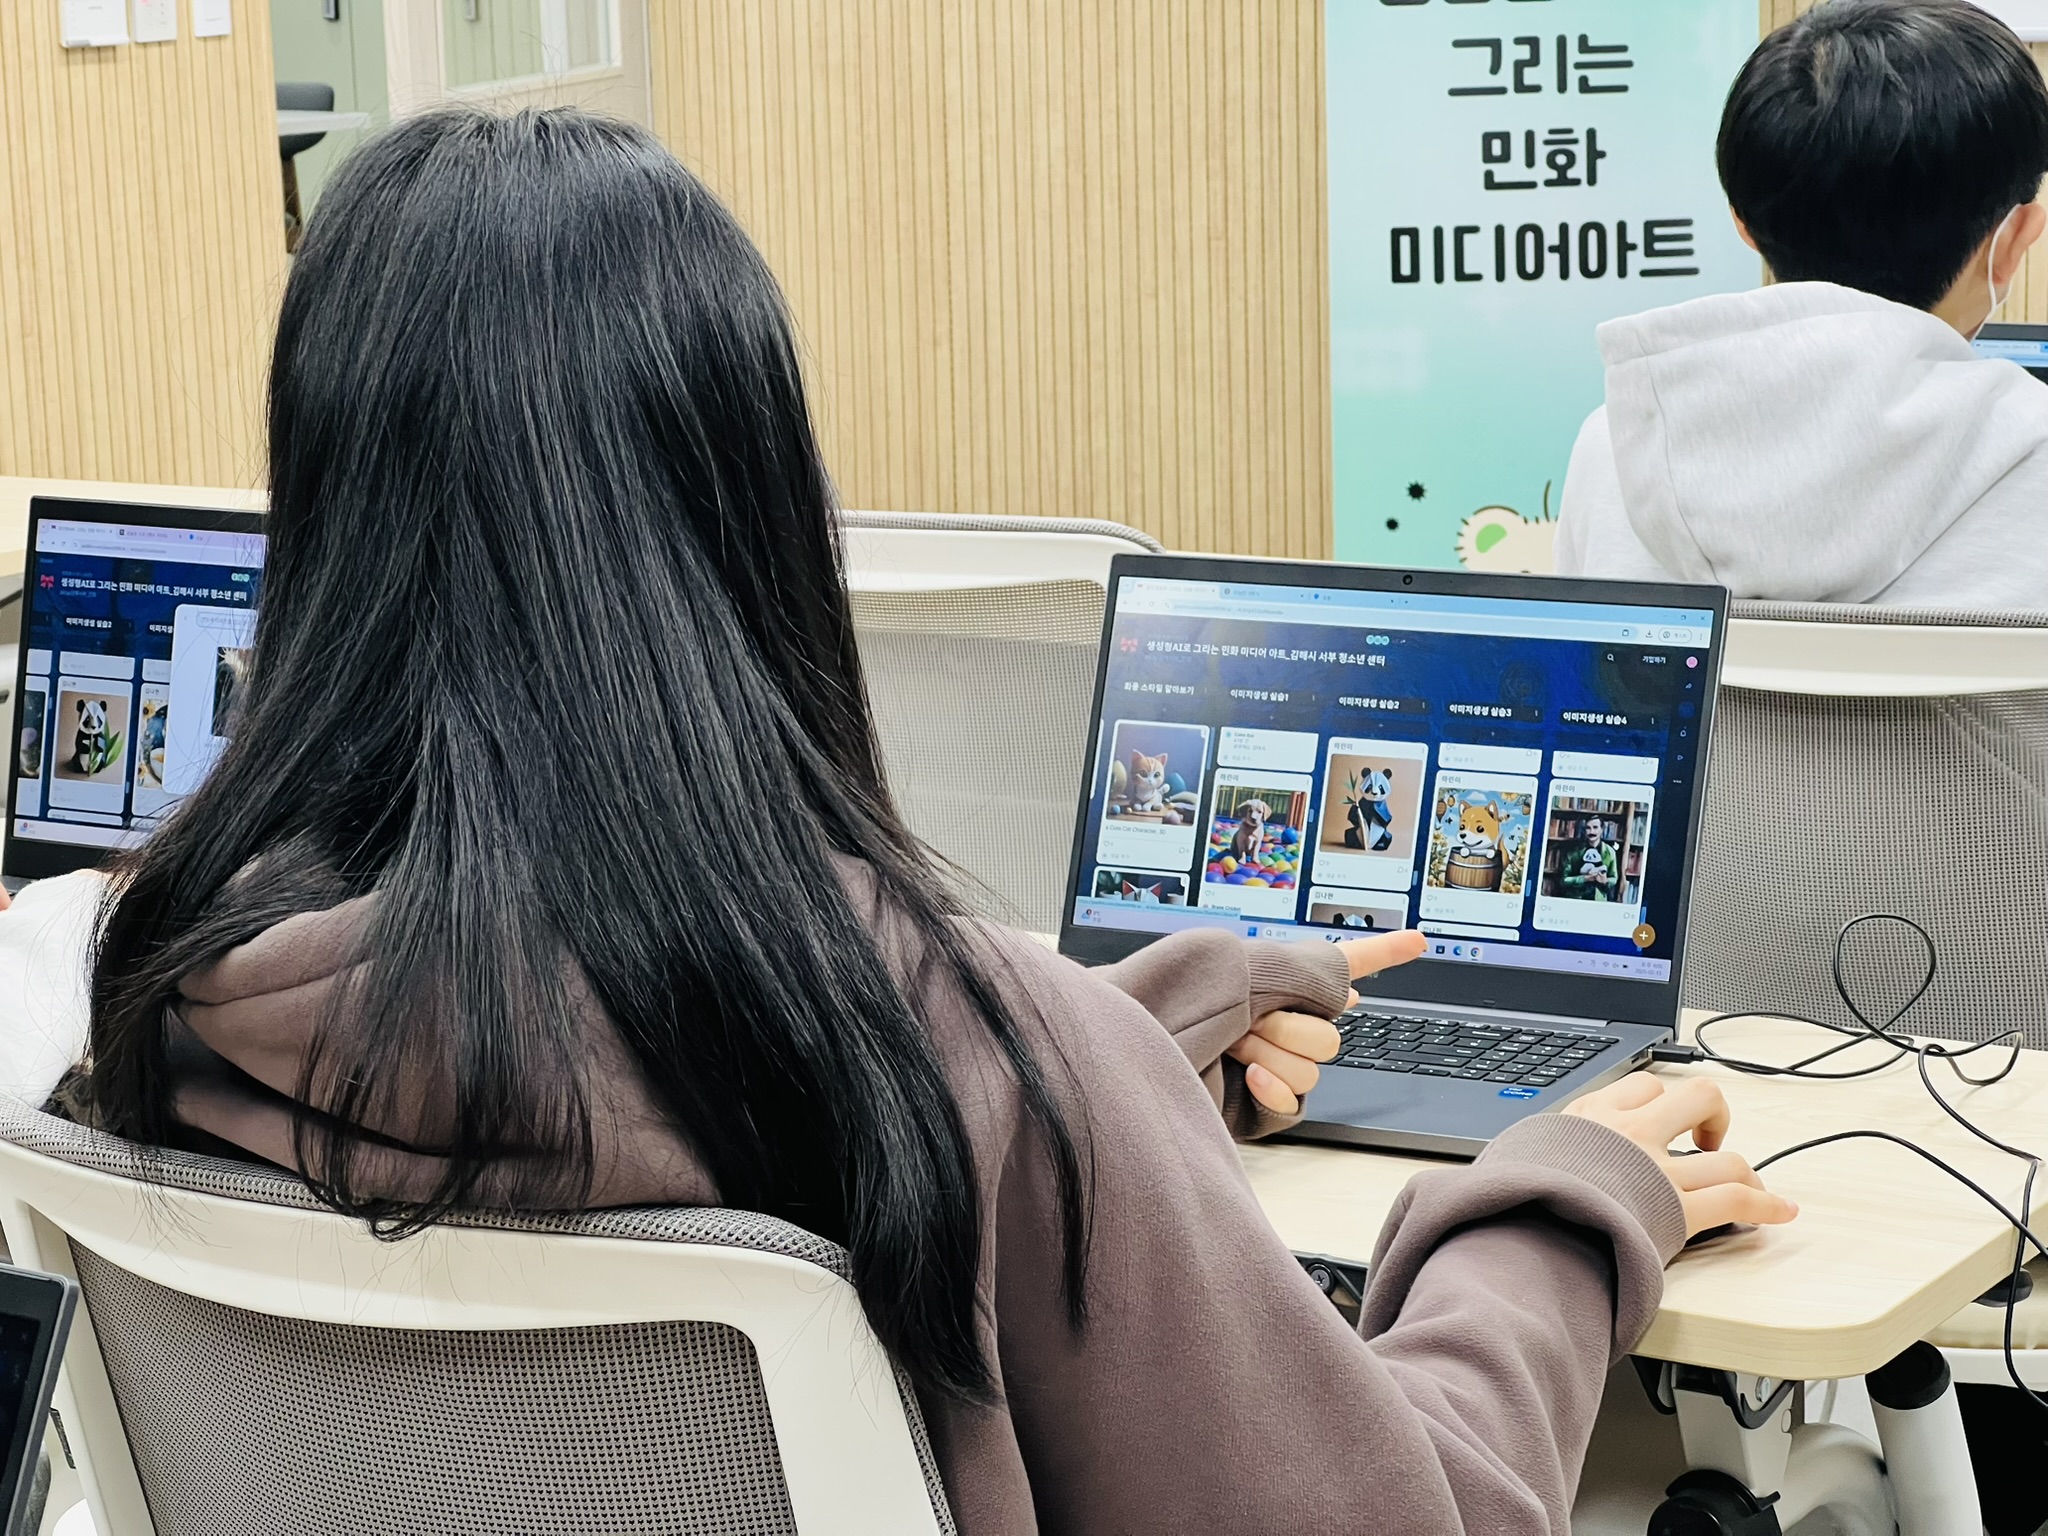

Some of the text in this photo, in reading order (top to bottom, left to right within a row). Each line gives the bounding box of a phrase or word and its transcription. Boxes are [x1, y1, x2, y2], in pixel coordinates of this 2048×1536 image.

[1448, 34, 1634, 96] 그리는
[1482, 128, 1607, 190] 민화
[1390, 218, 1700, 284] 미디어아트
[97, 580, 118, 591] 그리는
[134, 583, 155, 595] 미디어
[1146, 640, 1191, 654] 생성형AI로
[1193, 643, 1219, 656] 그리는
[1221, 645, 1239, 657] 민화
[1240, 646, 1267, 659] 미디어
[1318, 651, 1337, 663] 서부
[1338, 652, 1366, 666] 청소년
[1366, 655, 1386, 667] 센터
[1230, 689, 1289, 702] 이미지생성 실습1
[1338, 696, 1400, 710] 이미지생성 실습2
[1449, 703, 1512, 718] 이미지생성 실습3
[1562, 711, 1628, 726] 이미지생성 실습4
